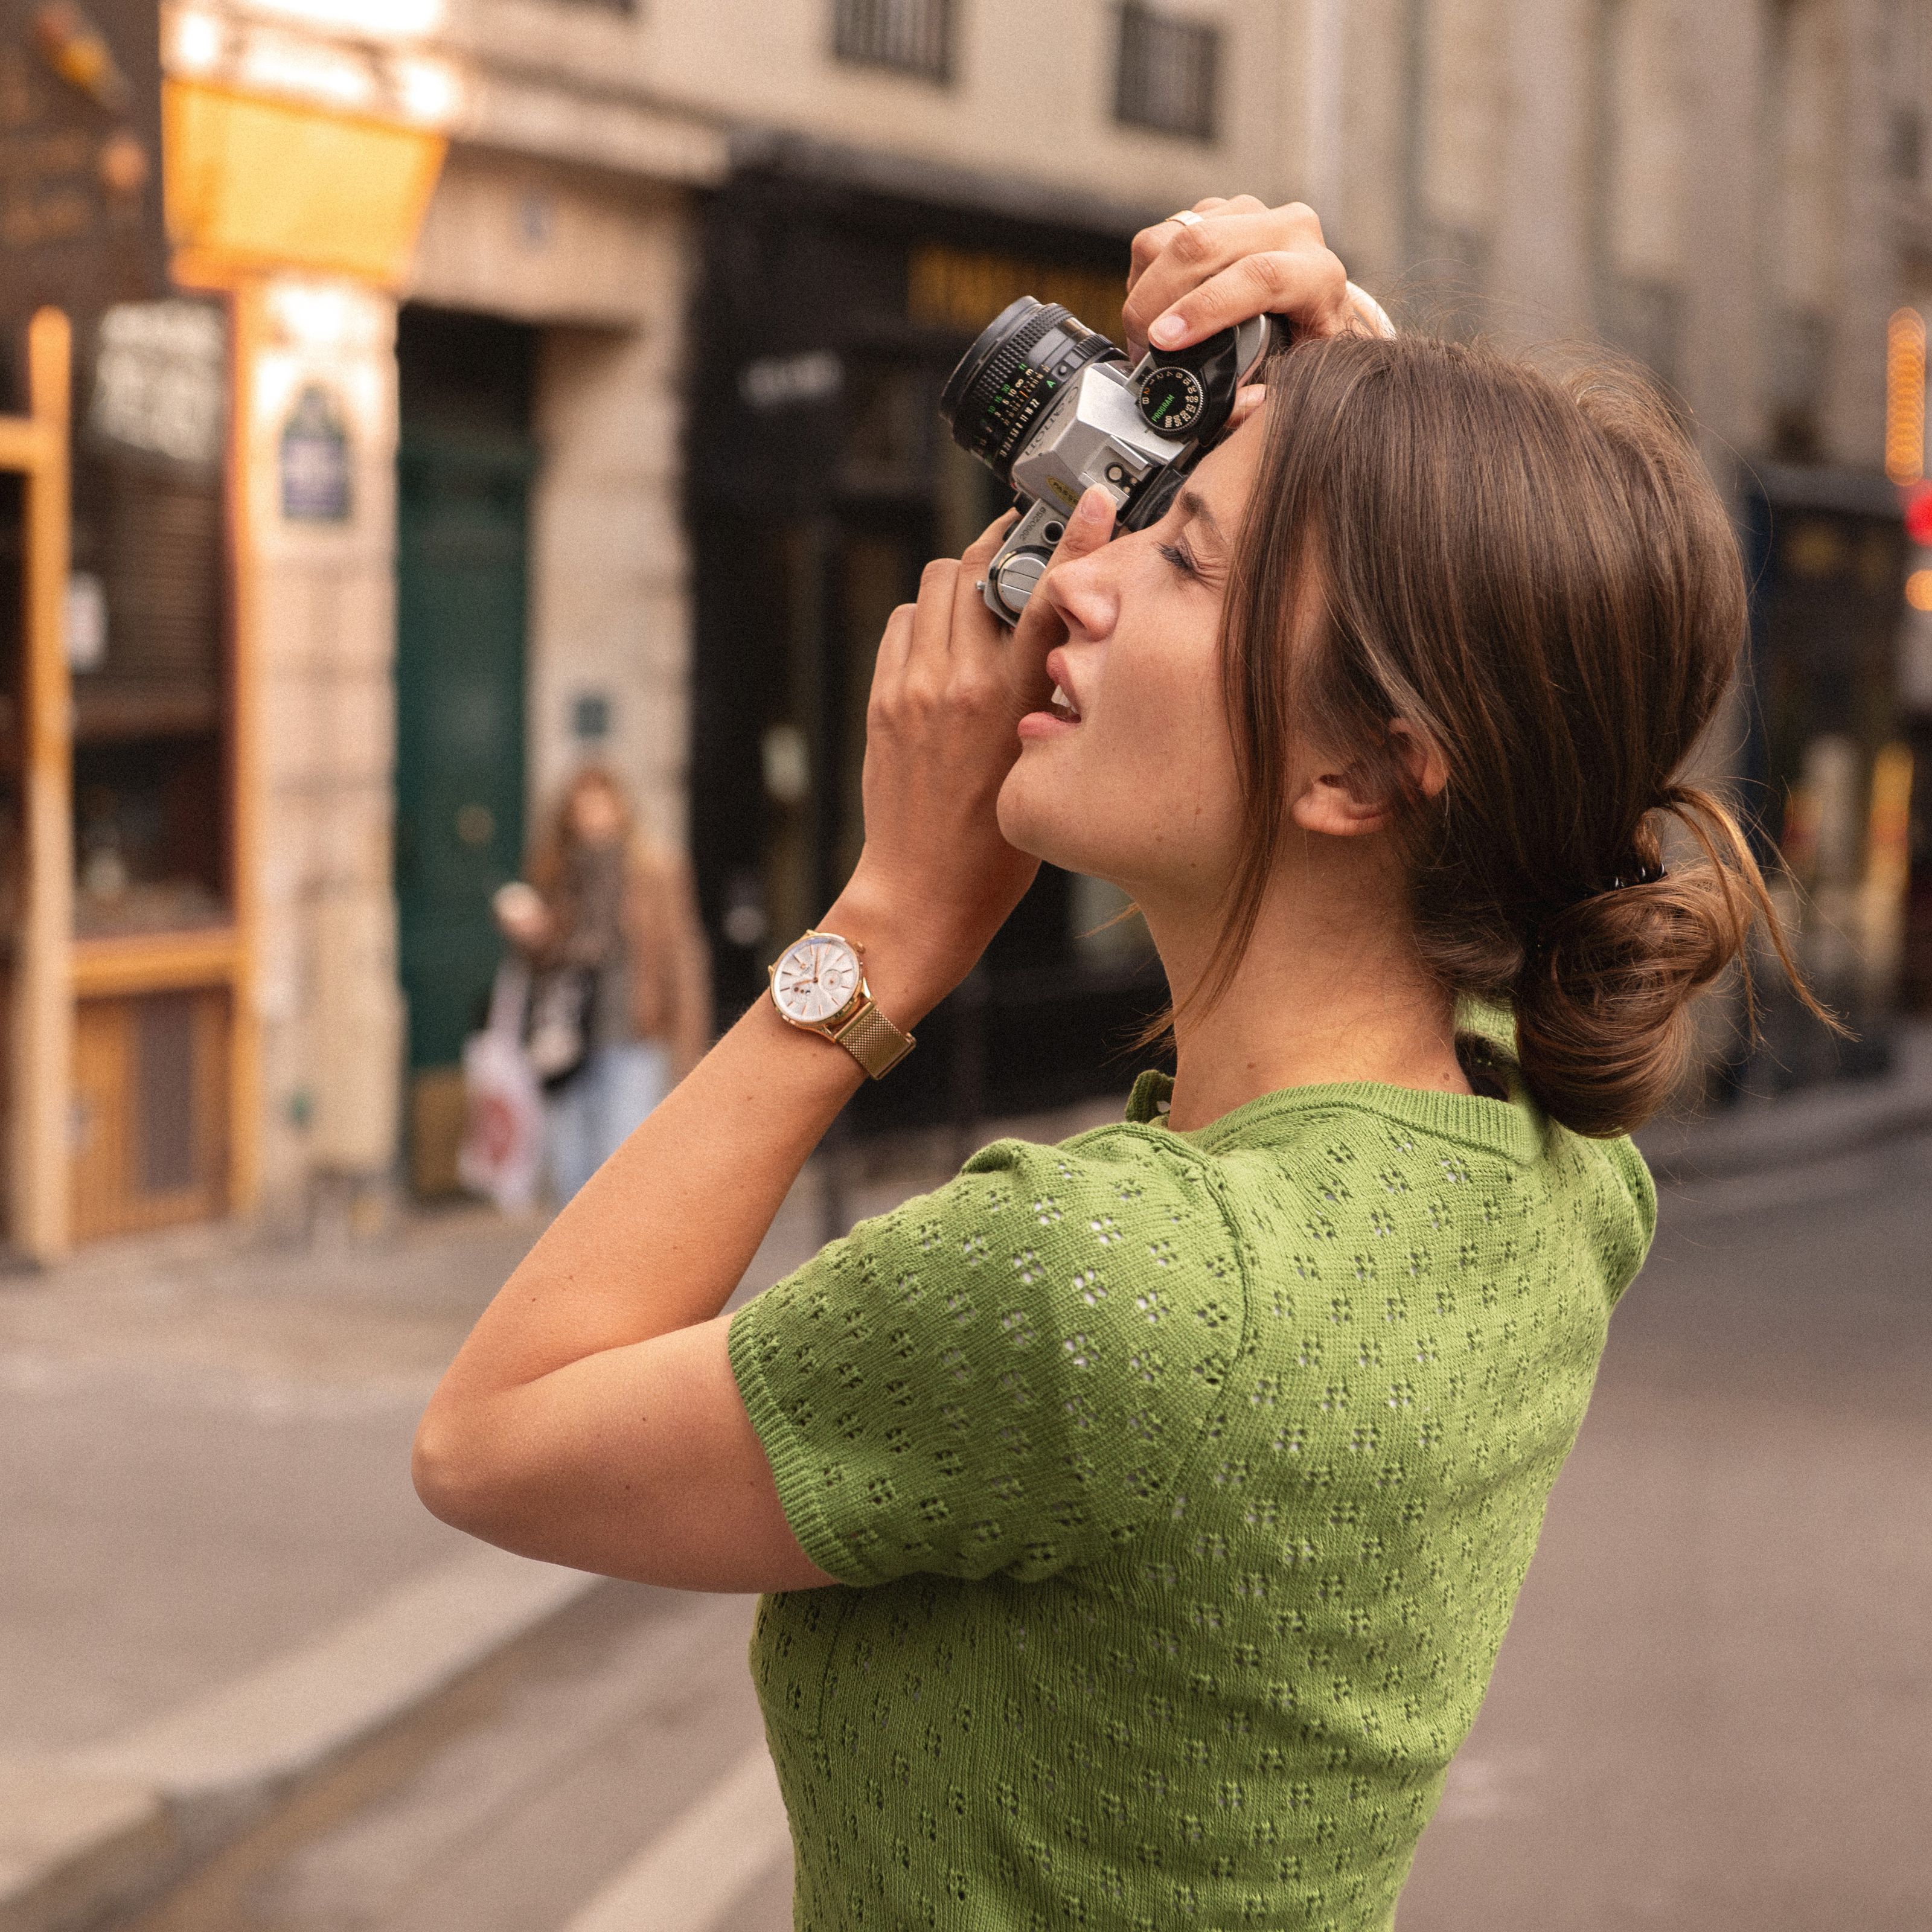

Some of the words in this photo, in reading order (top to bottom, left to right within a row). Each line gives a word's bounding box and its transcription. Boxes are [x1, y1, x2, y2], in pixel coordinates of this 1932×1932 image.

[1008, 388, 1017, 397] 10
[1020, 414, 1029, 423] 11
[1029, 398, 1040, 408] 22
[1046, 380, 1056, 389] A
[1151, 394, 1175, 423] PROGRAM
[1174, 415, 1182, 427] 500
[1180, 411, 1191, 421] 250
